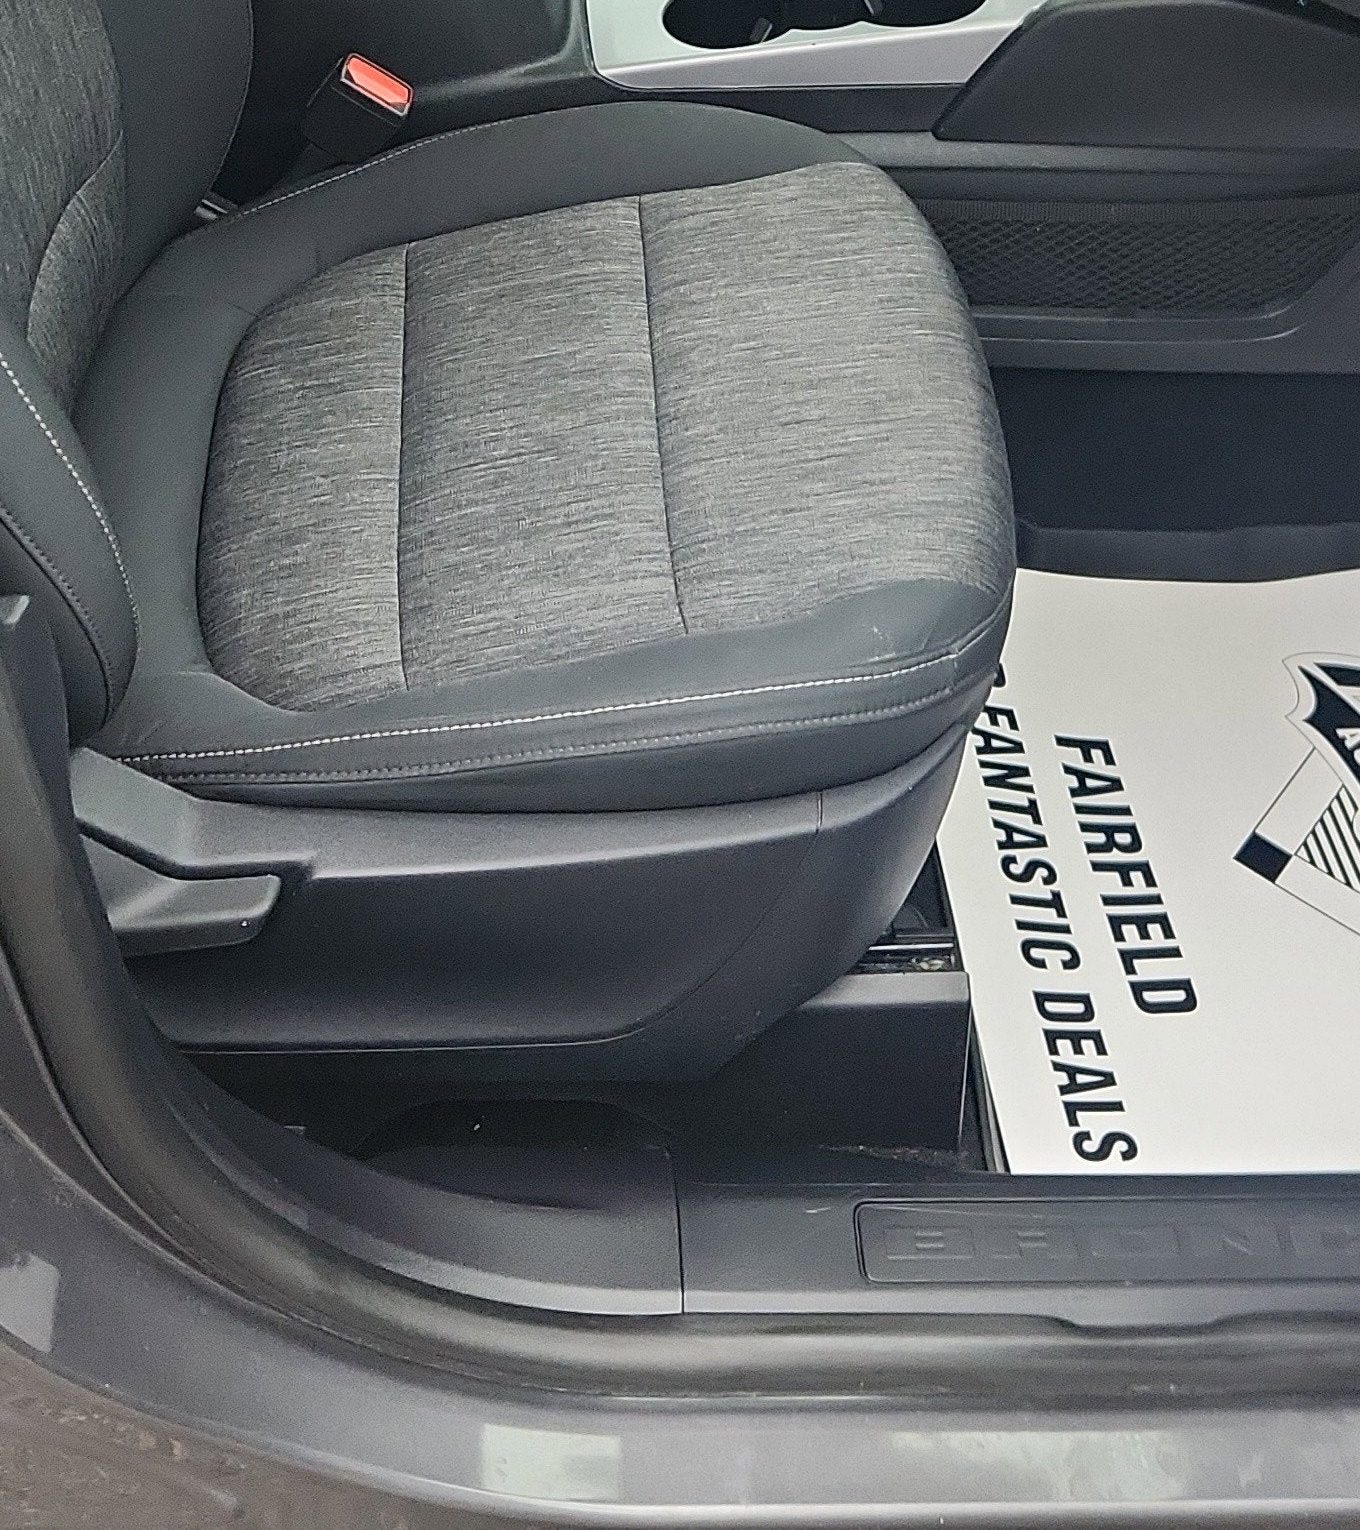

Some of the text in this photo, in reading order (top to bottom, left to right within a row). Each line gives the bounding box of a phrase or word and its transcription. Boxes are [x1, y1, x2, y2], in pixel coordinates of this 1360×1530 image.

[970, 704, 1139, 1163] FANTASTIC DEALS
[1053, 734, 1198, 1015] FAIRFIELD
